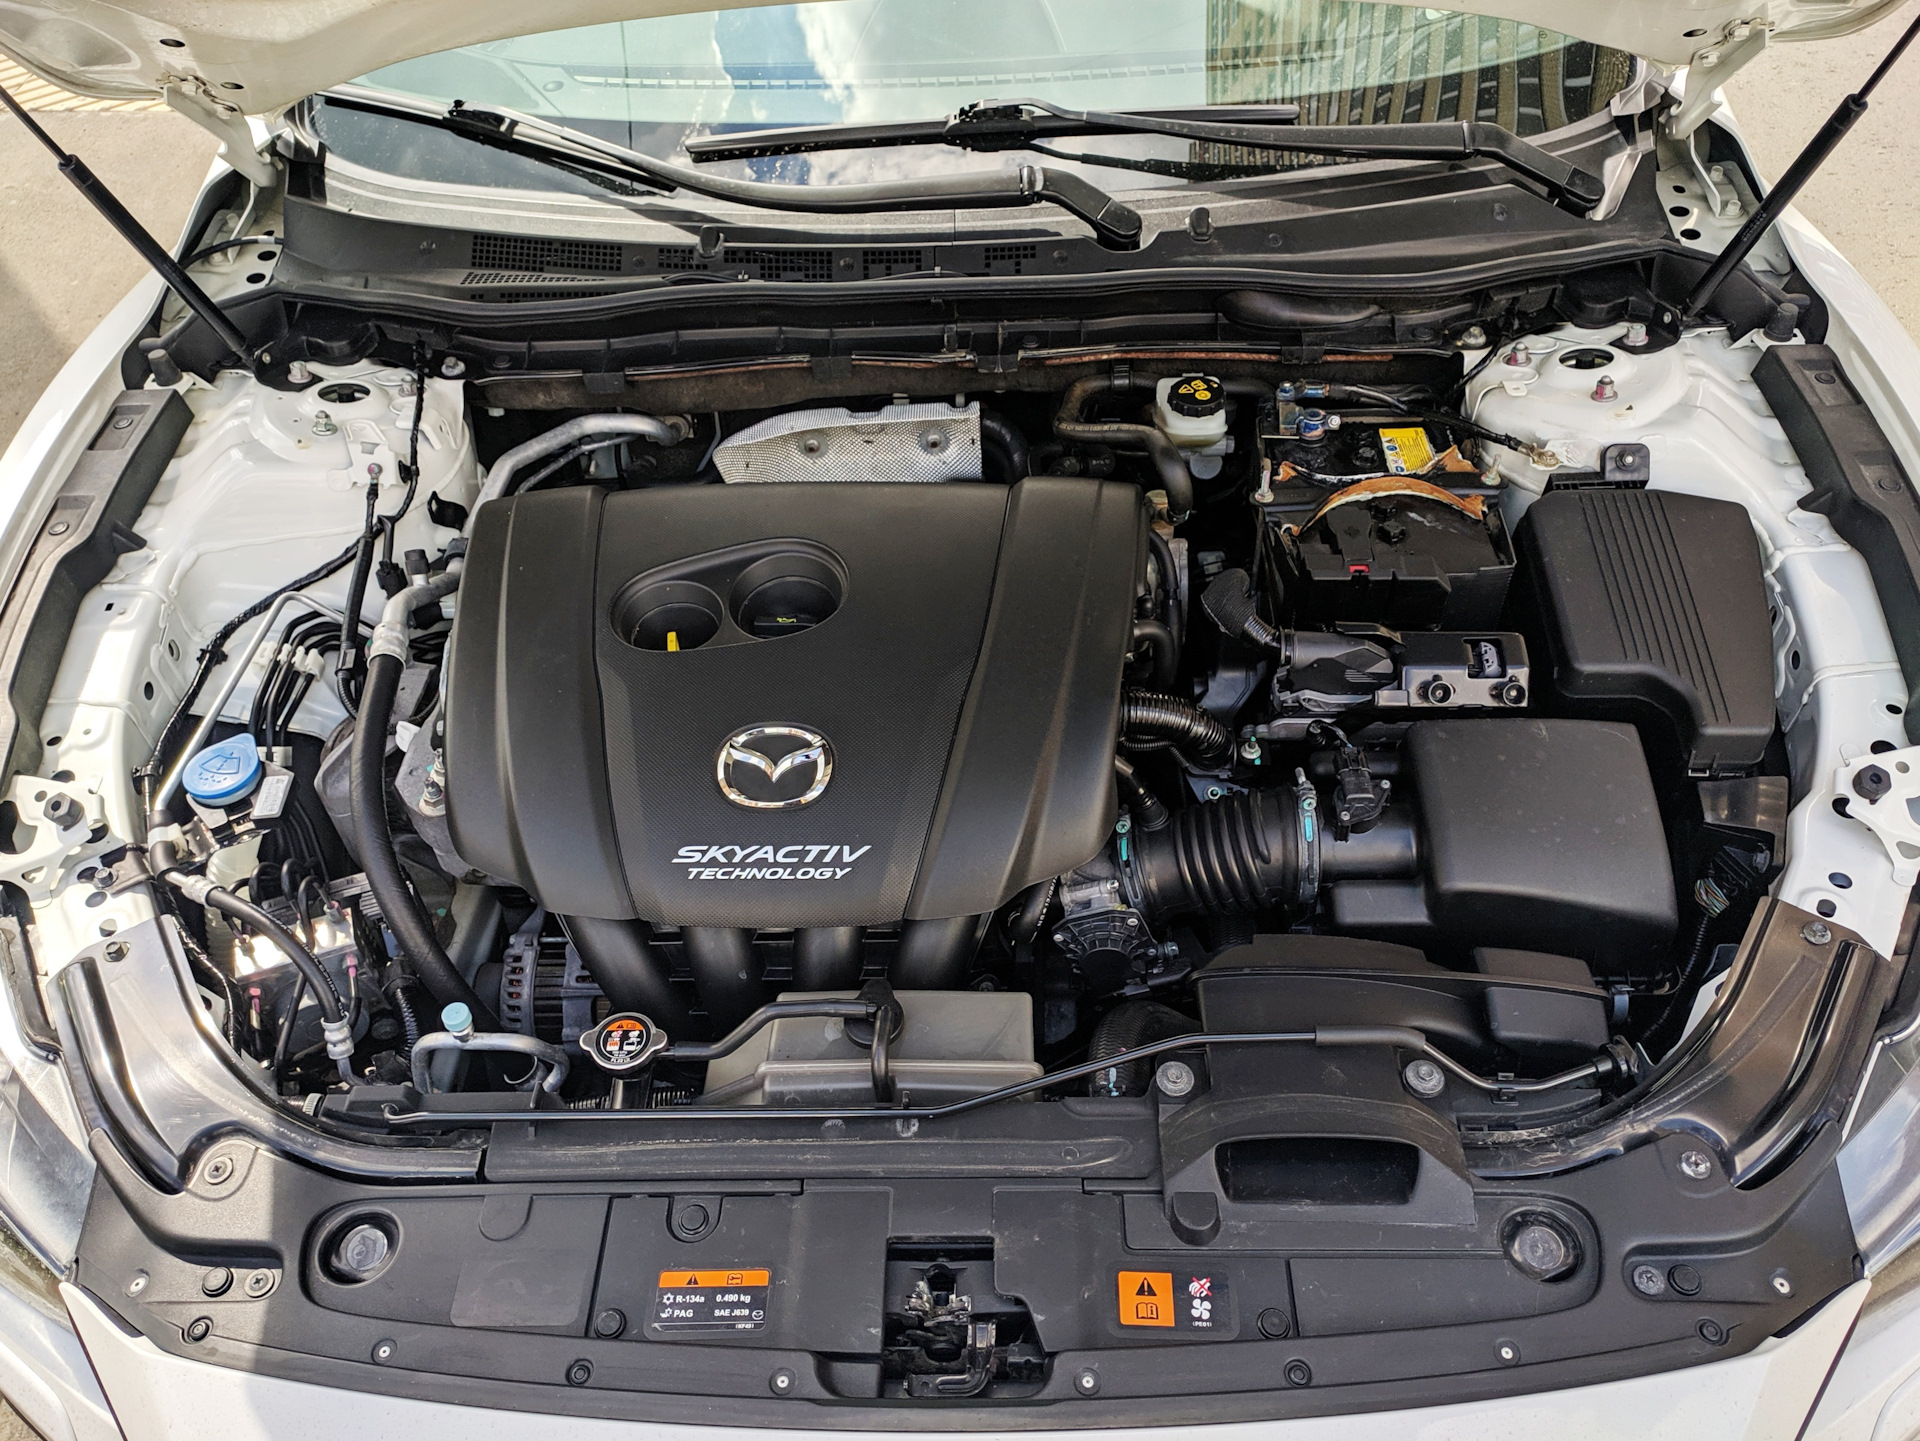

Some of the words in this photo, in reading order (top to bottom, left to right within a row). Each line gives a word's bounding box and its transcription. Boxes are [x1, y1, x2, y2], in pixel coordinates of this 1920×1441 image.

[671, 845, 872, 863] SKYACTIV
[687, 867, 852, 880] TECHNOLOGY
[675, 1294, 705, 1303] R-134a
[715, 1294, 739, 1303] 0.490
[739, 1293, 751, 1304] kg
[673, 1309, 694, 1318] PAG
[713, 1309, 731, 1317] SAE
[731, 1308, 750, 1316] J639
